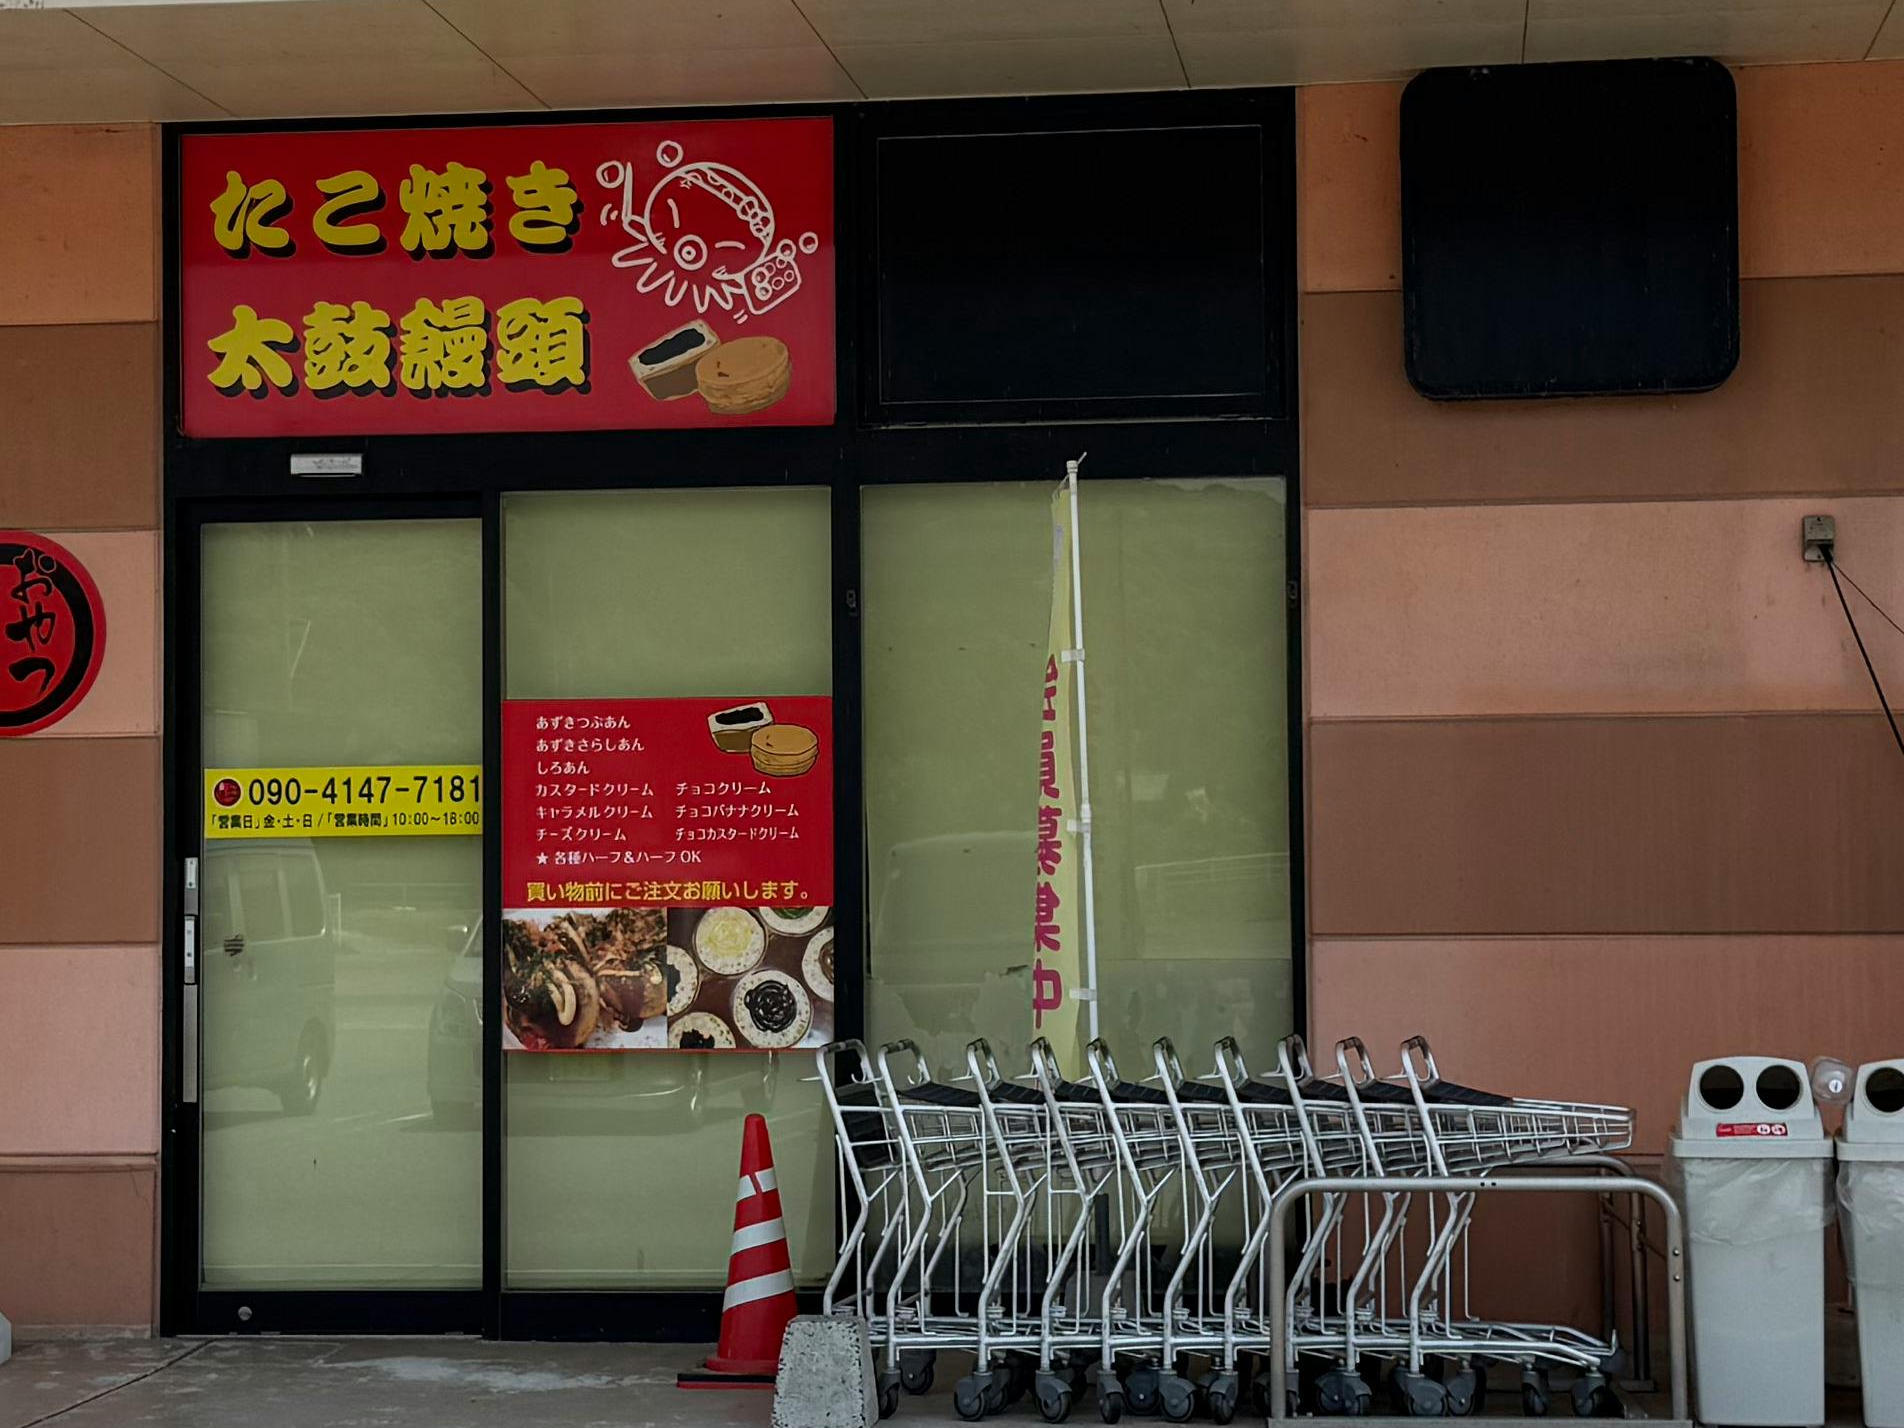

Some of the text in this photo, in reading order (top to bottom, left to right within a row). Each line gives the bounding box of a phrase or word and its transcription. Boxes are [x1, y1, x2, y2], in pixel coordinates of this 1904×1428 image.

[210, 160, 580, 255] たこ焼き
[208, 294, 588, 392] 太鼓饅頭
[535, 715, 631, 730] あずきつぶあん
[535, 737, 645, 753] あずきさらしあん
[537, 760, 591, 776] しろあん
[248, 774, 480, 806] 090-4147-7181
[535, 782, 655, 798] カスタードクリーム
[675, 781, 772, 796] チョコクリーム
[535, 805, 654, 820] キャラメルクリーム
[675, 803, 800, 819] チョコバナナクリーム
[535, 827, 627, 842] チーズクリーム
[675, 826, 800, 841] チョコカスタードクリーム
[526, 880, 809, 903] 買い物前にご注文お願いします。
